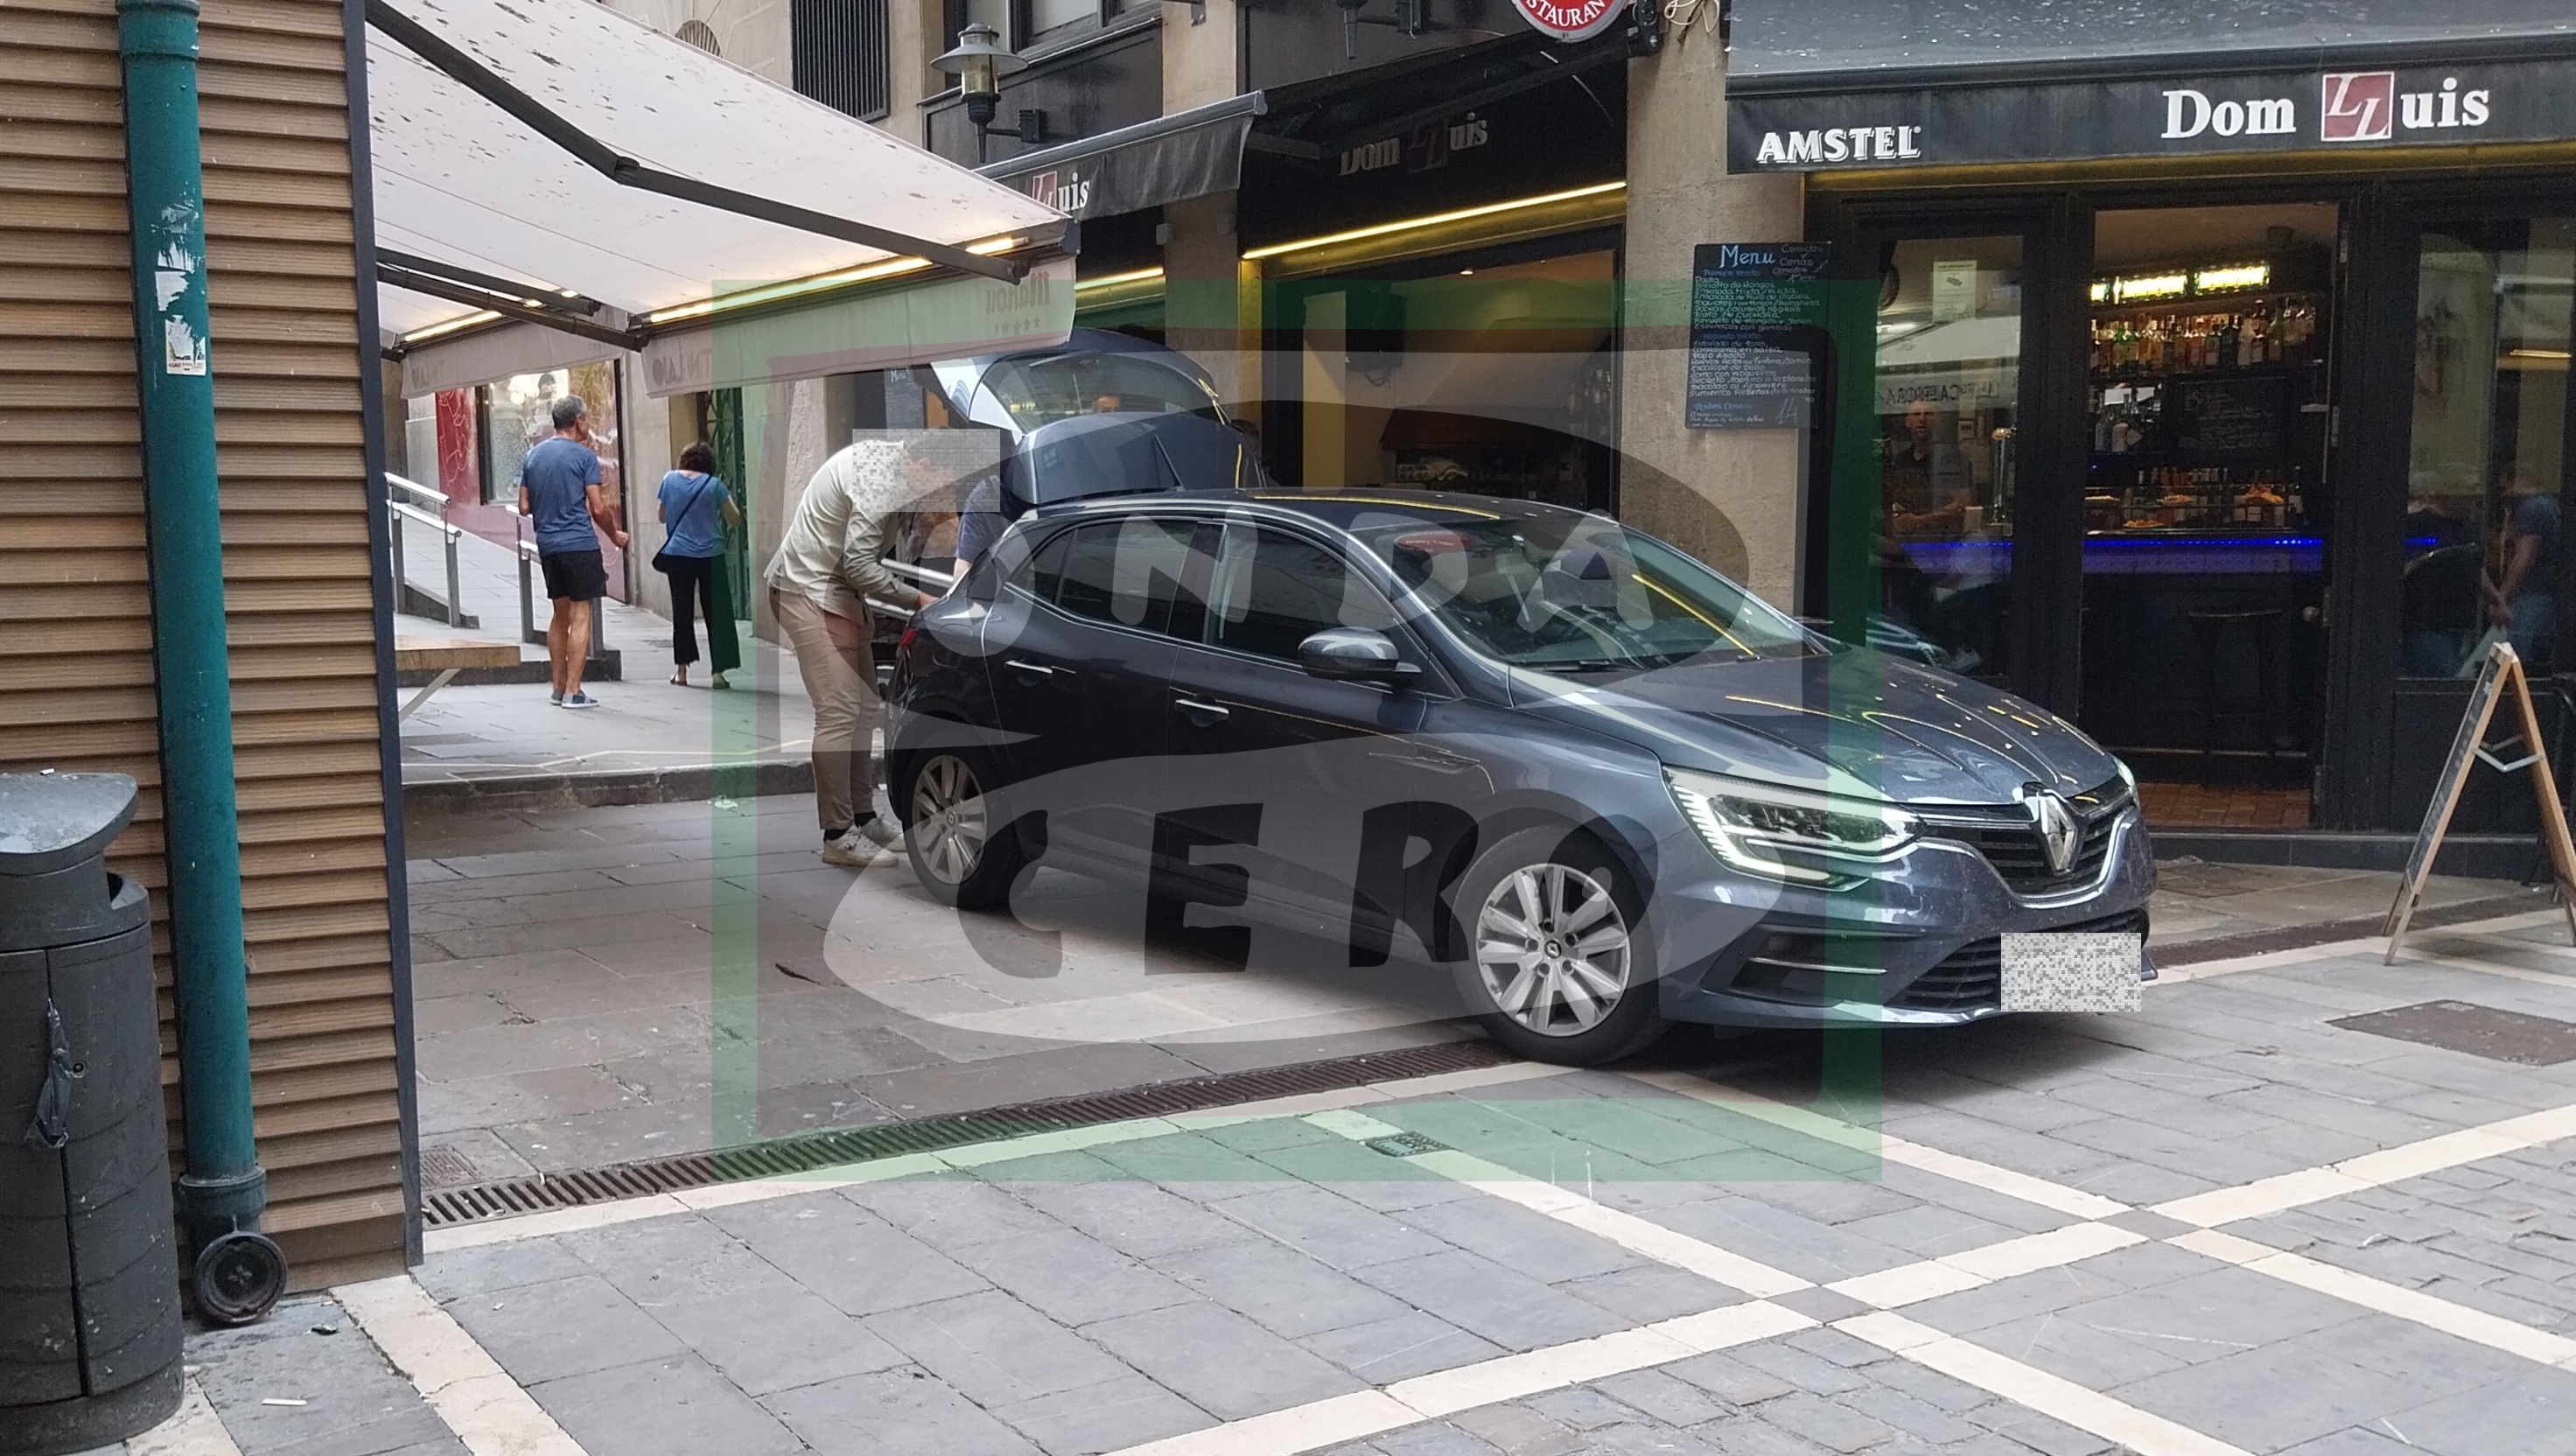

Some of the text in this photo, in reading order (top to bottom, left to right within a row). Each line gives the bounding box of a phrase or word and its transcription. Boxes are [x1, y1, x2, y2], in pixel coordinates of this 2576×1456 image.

[2161, 89, 2297, 139] Dom
[1756, 125, 1922, 164] AMSTEL
[1780, 257, 1815, 267] Cenas
